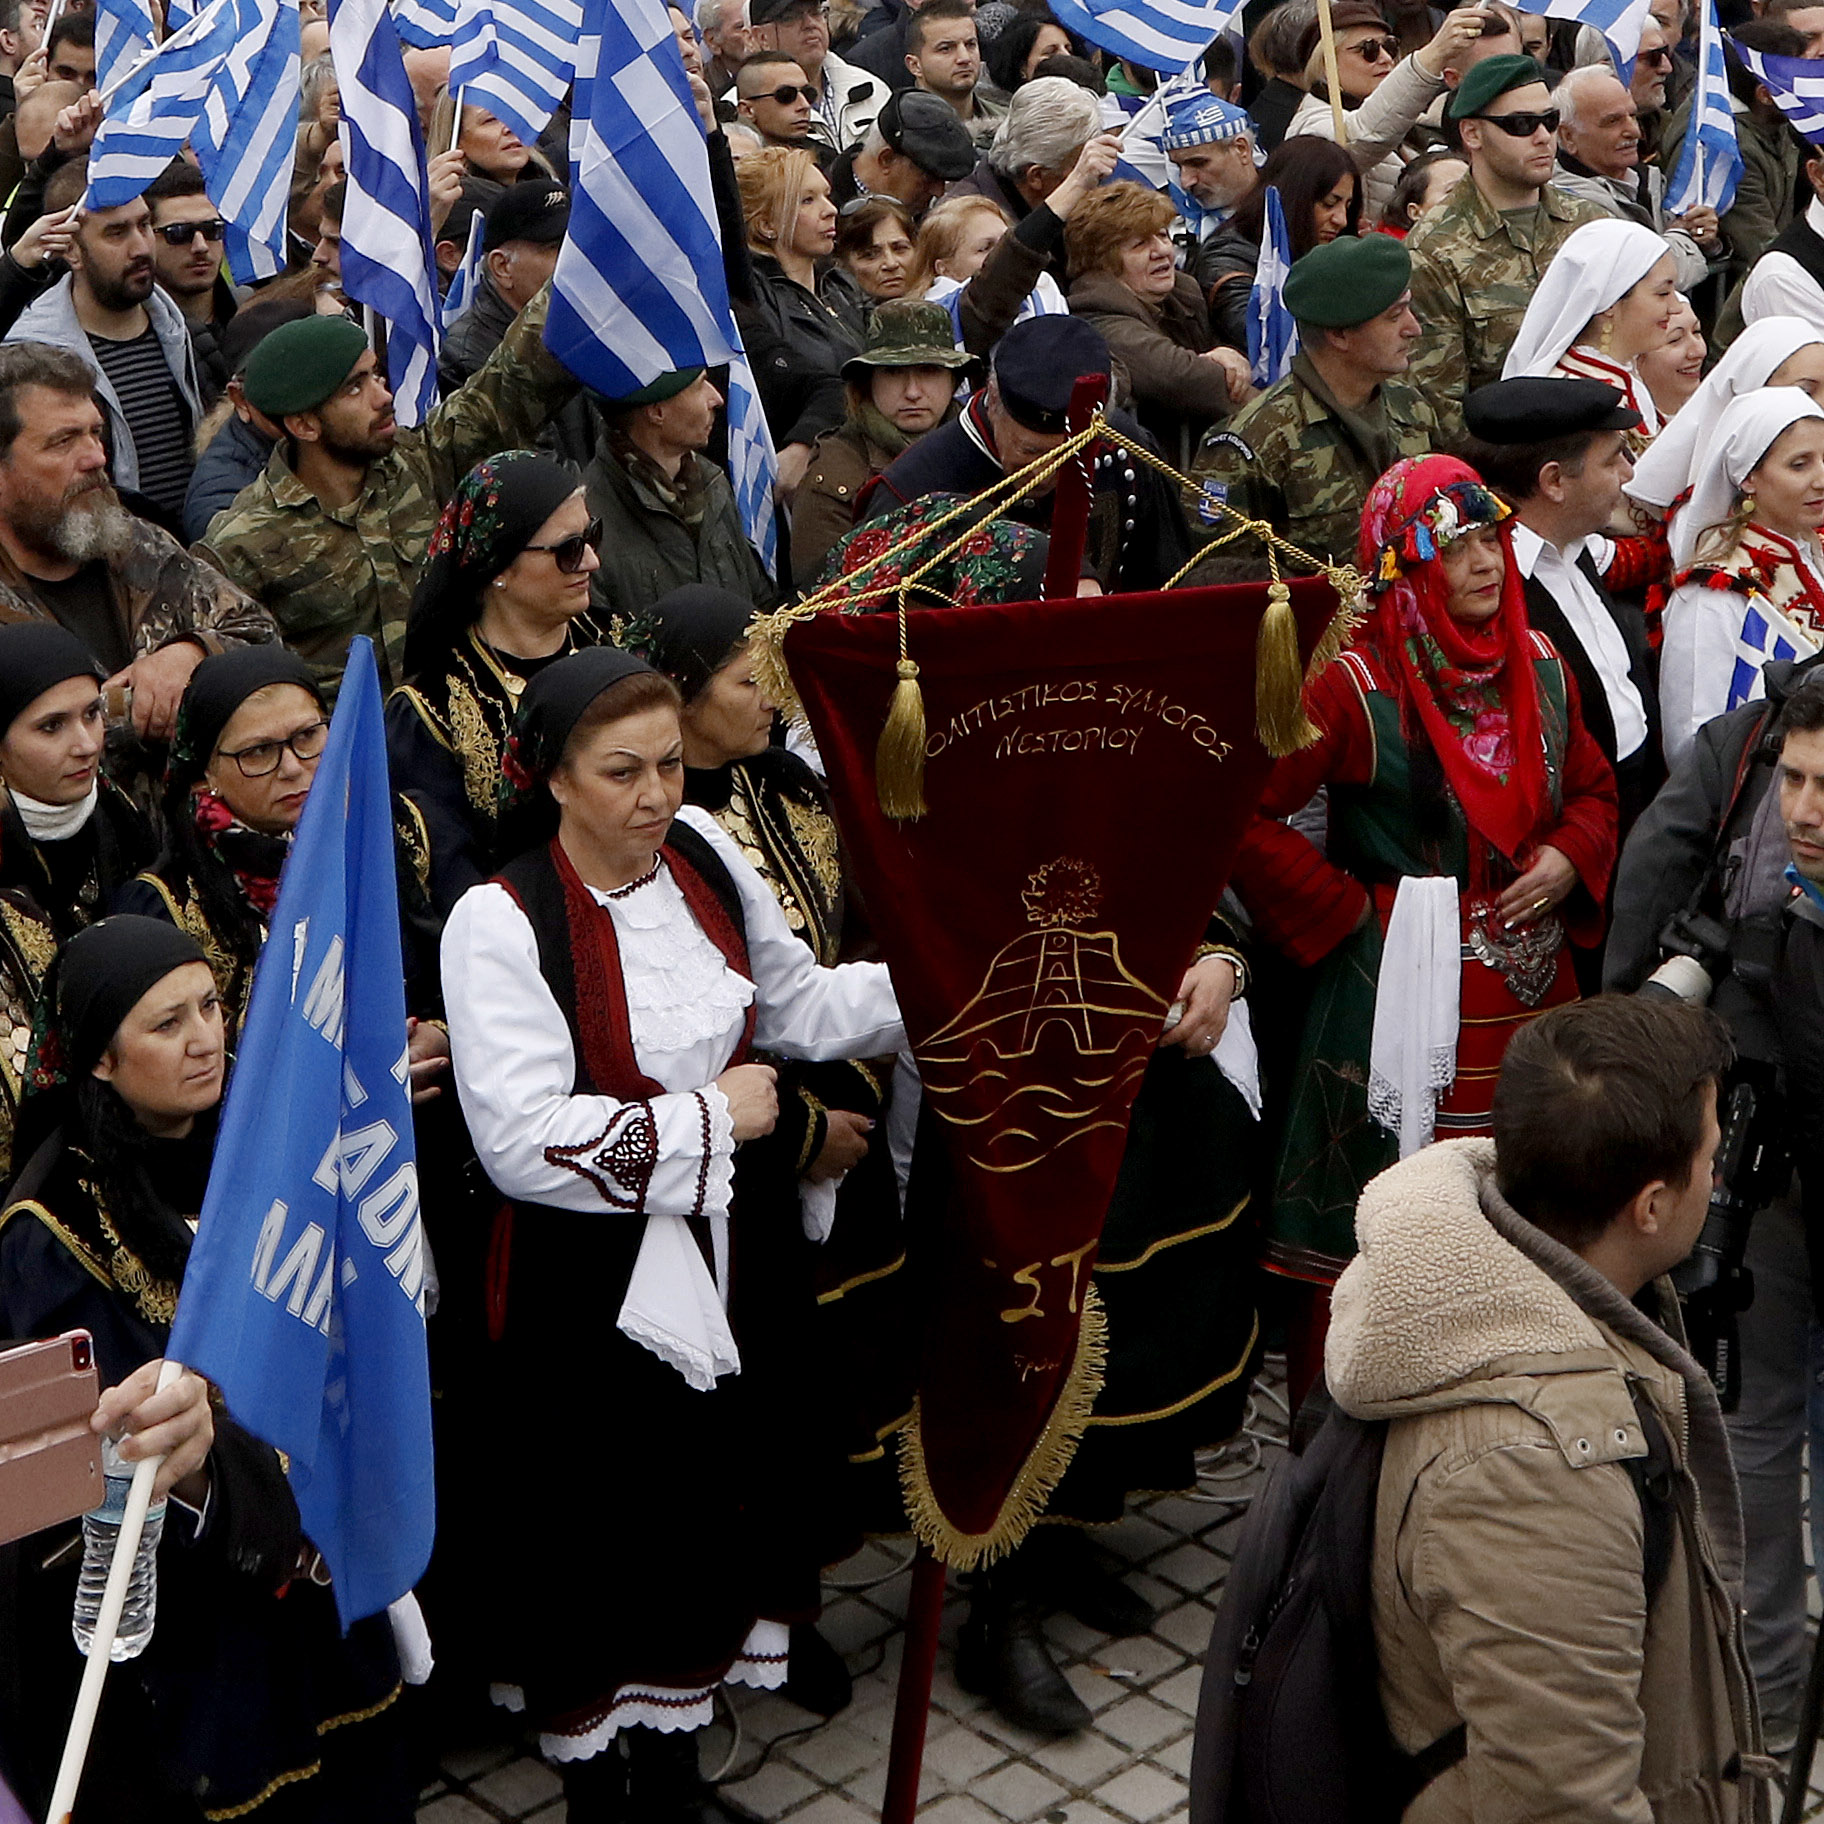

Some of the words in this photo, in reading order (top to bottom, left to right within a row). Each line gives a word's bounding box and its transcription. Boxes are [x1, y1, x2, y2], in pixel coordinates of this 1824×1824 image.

[925, 680, 1098, 758] ΟΛΙΤΙΣΤΙΚΟΣ
[1104, 683, 1234, 763] ΣΥΛΛΟΓΟΣ
[995, 725, 1144, 759] ΝΕΣΤΟΡΙΟΥ
